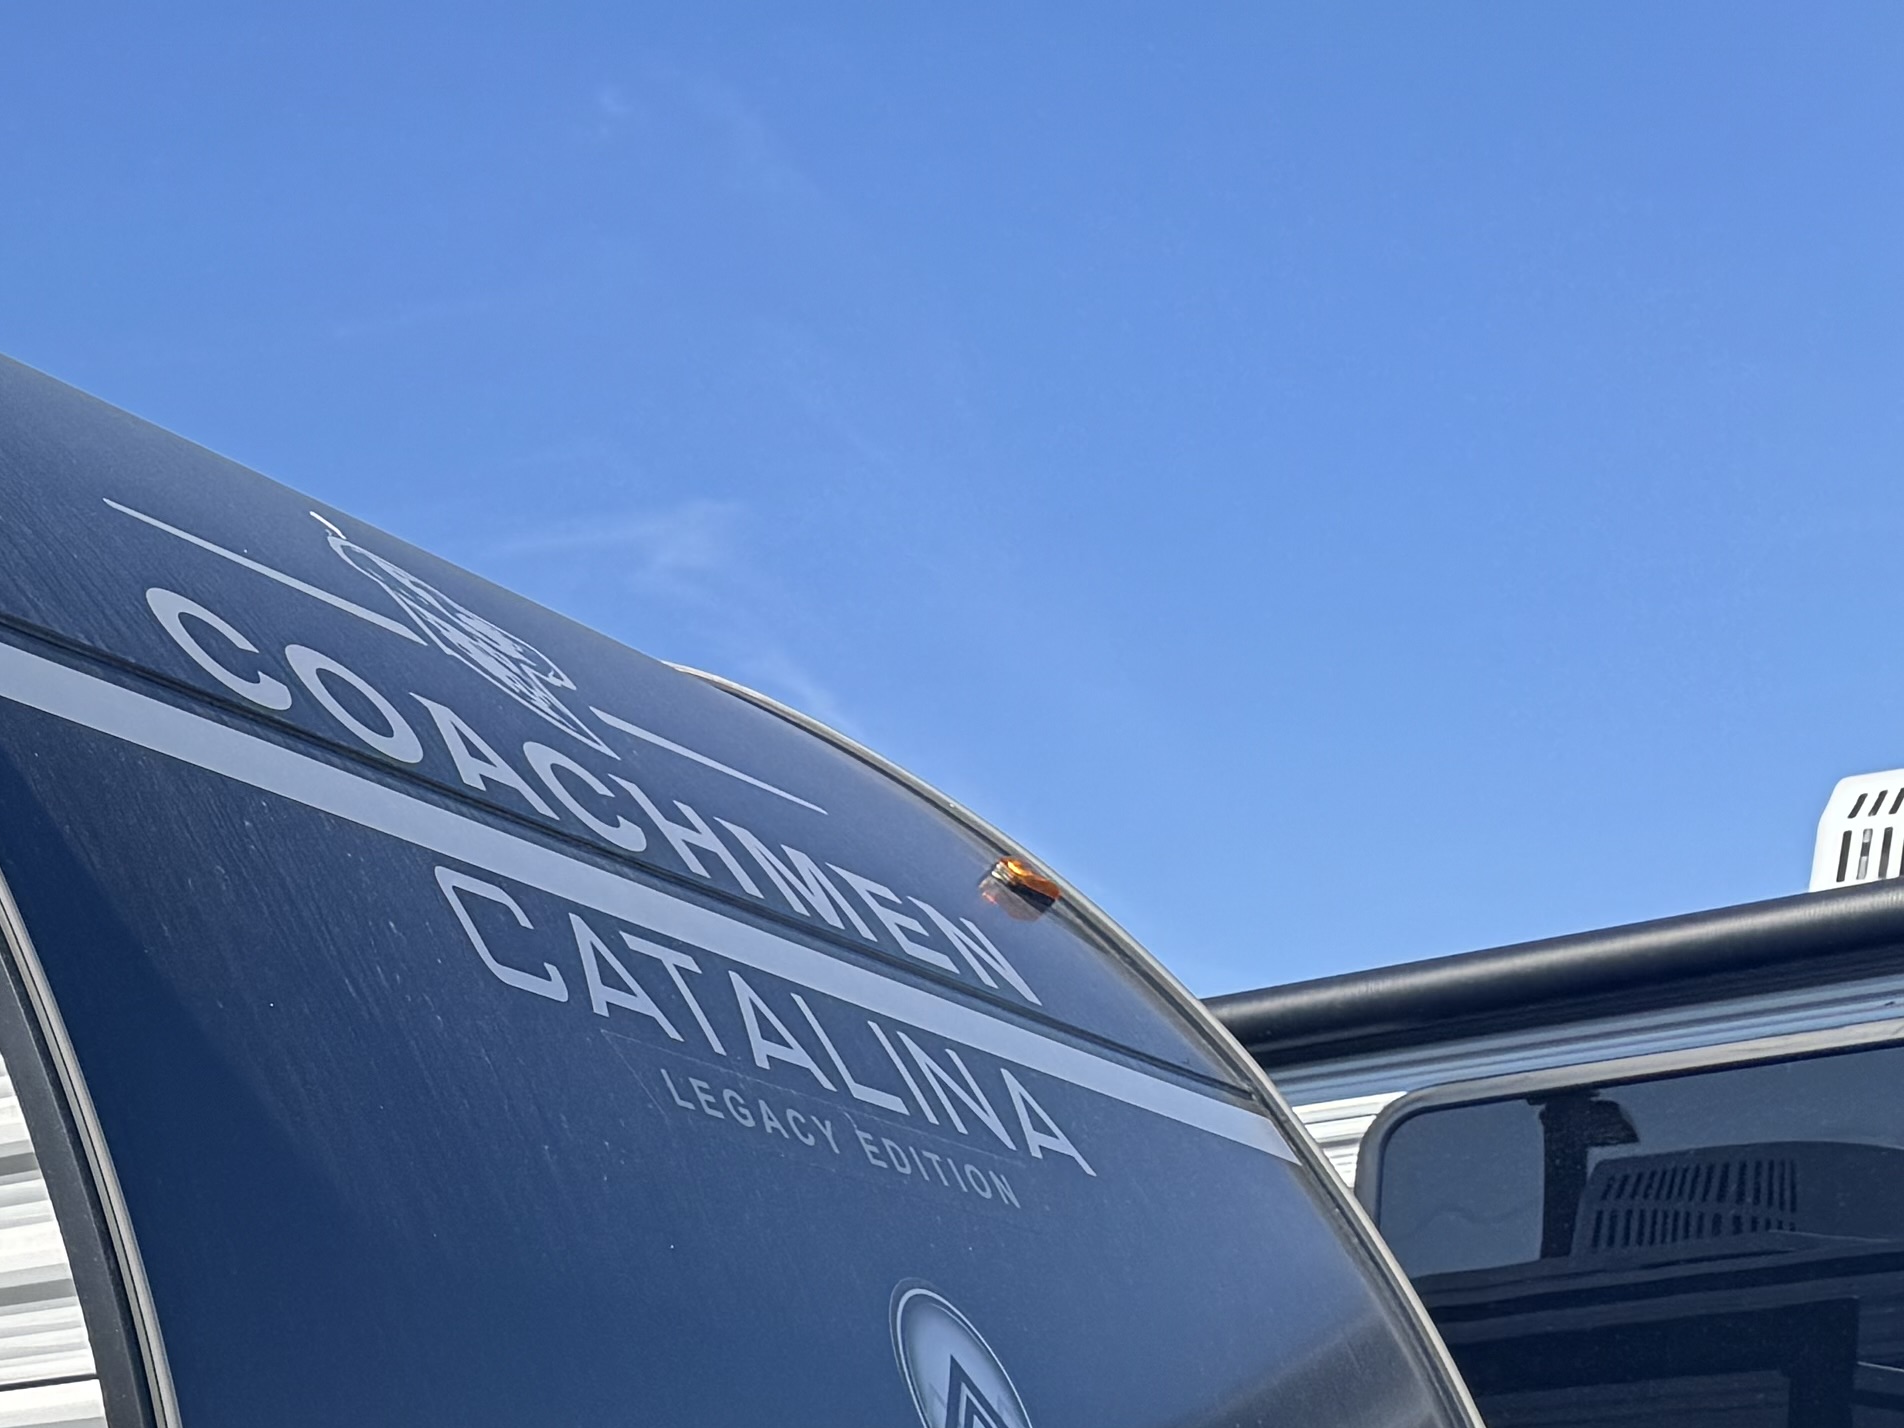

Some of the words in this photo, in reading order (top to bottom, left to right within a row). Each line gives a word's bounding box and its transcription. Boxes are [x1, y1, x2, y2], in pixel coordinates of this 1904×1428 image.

[145, 586, 1042, 1007] COACHMEN
[434, 865, 1097, 1177] CATALINA
[660, 1068, 840, 1155] LEGACY
[855, 1131, 1021, 1209] EDITION
